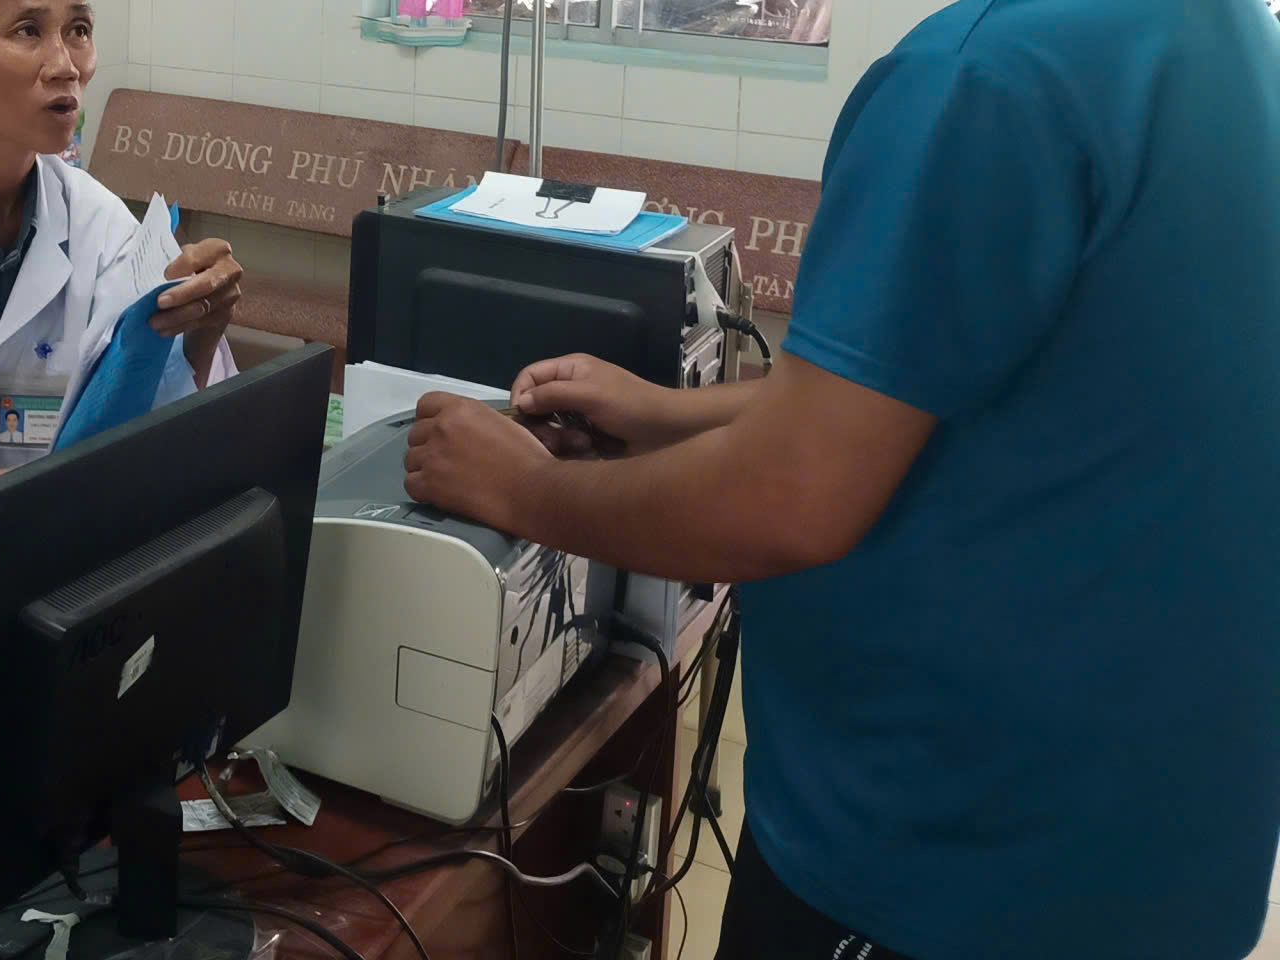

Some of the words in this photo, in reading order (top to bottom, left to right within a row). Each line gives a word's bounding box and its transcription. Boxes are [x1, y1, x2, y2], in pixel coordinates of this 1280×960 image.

[112, 125, 153, 157] BS
[161, 131, 273, 175] DƯƠNG
[287, 150, 365, 188] PHÚ
[744, 215, 809, 257] PH
